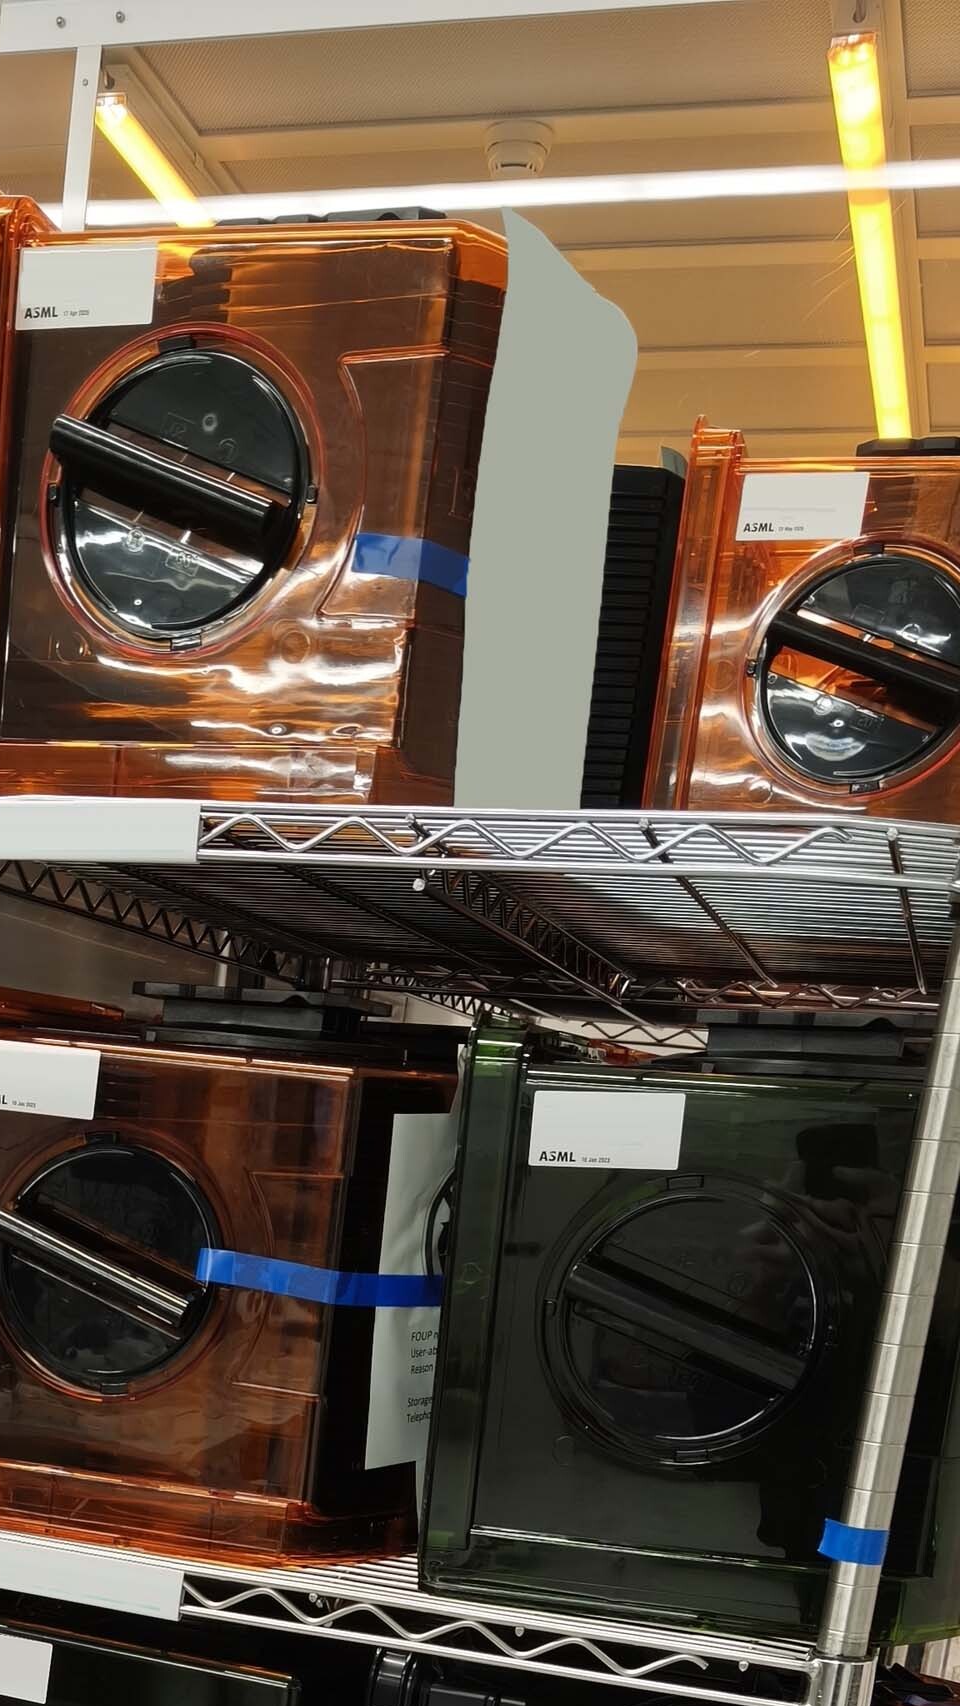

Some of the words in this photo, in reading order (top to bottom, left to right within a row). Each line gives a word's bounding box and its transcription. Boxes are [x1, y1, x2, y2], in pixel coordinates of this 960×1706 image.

[24, 306, 58, 319] ASML
[743, 522, 774, 532] ASML
[539, 1151, 576, 1162] ASML
[411, 1330, 433, 1342] FOUP
[410, 1363, 434, 1375] Reason
